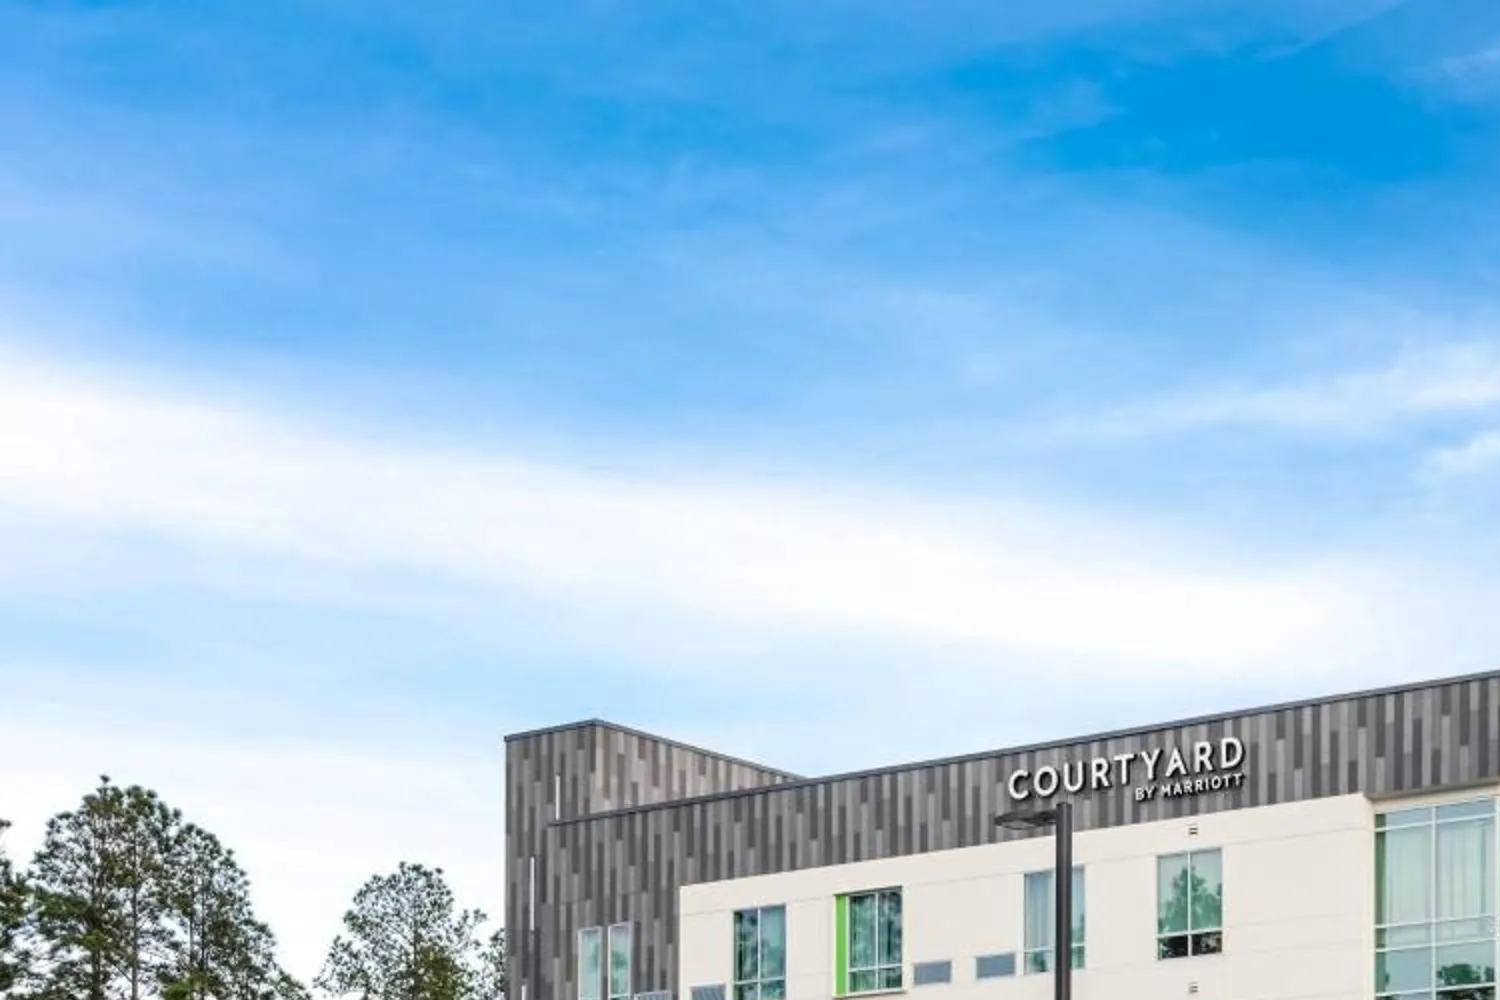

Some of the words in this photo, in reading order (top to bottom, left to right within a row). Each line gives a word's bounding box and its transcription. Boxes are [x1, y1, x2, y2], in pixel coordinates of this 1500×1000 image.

[1007, 736, 1244, 800] COURTYARD
[1135, 786, 1155, 801] BY
[1161, 773, 1243, 797] MARRIOTT
